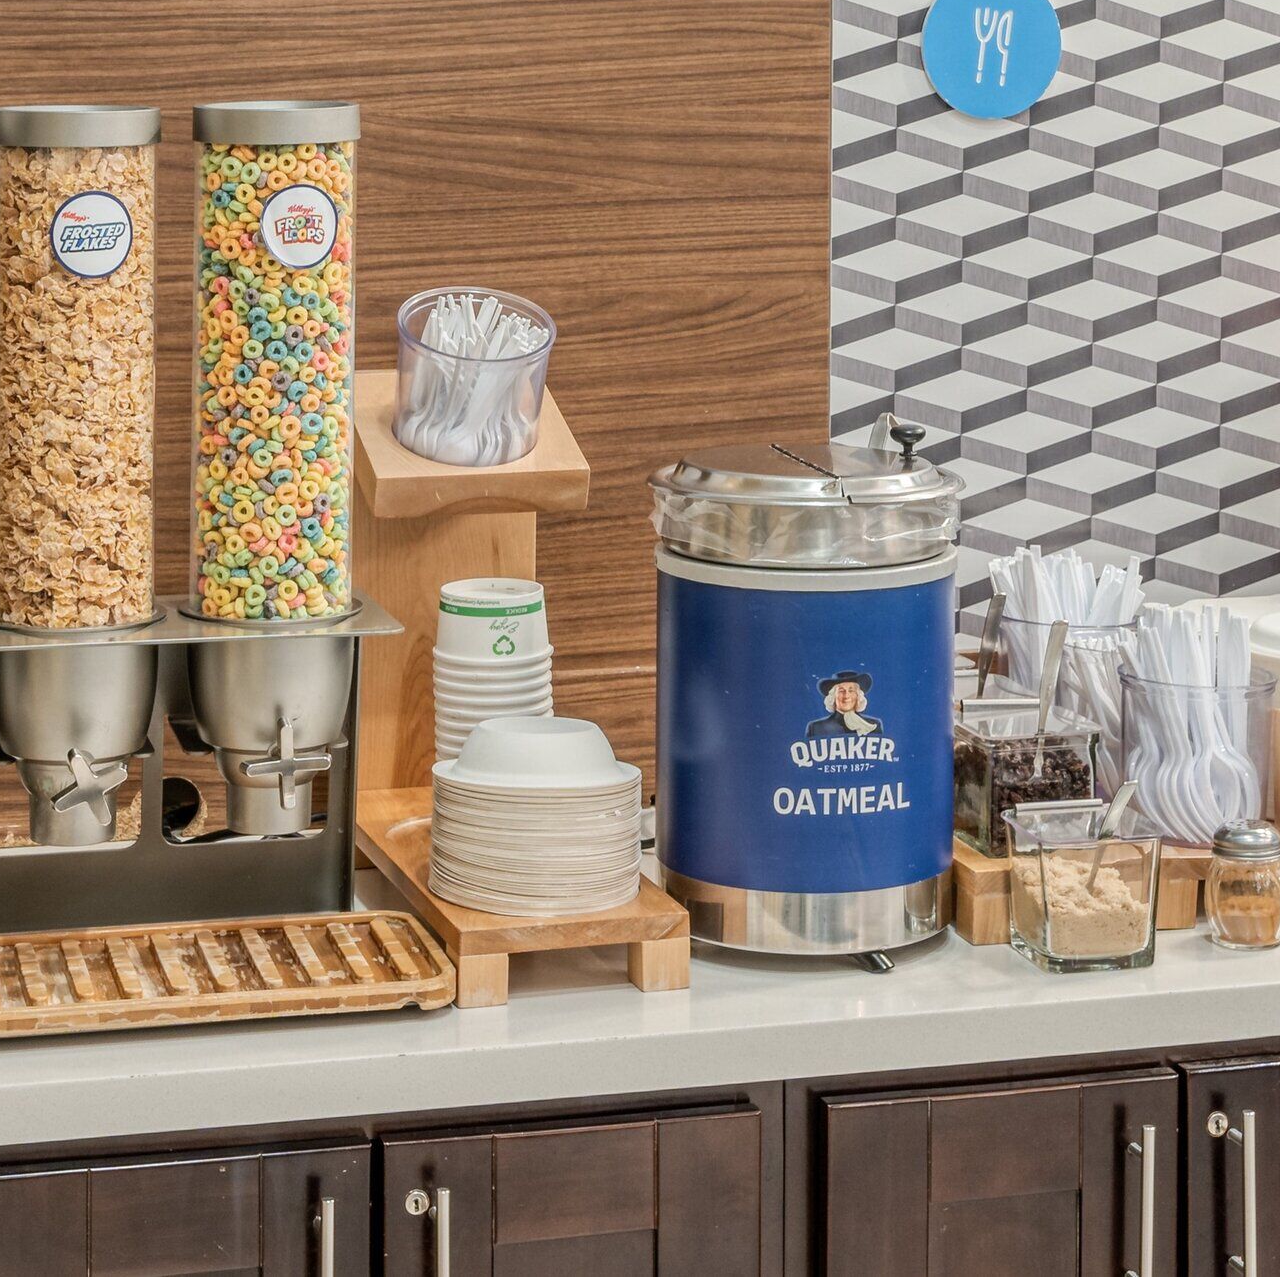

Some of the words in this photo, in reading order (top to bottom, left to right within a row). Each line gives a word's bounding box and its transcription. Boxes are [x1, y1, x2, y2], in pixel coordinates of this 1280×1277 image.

[287, 204, 315, 214] Kellogg's
[61, 223, 125, 240] FROSTED
[276, 215, 322, 235] FROOT
[61, 236, 117, 252] FLAKES
[283, 227, 325, 244] LOOPS
[505, 607, 528, 615] REDUCE
[790, 736, 896, 768] QUAKER
[773, 782, 910, 815] OATMEAL
